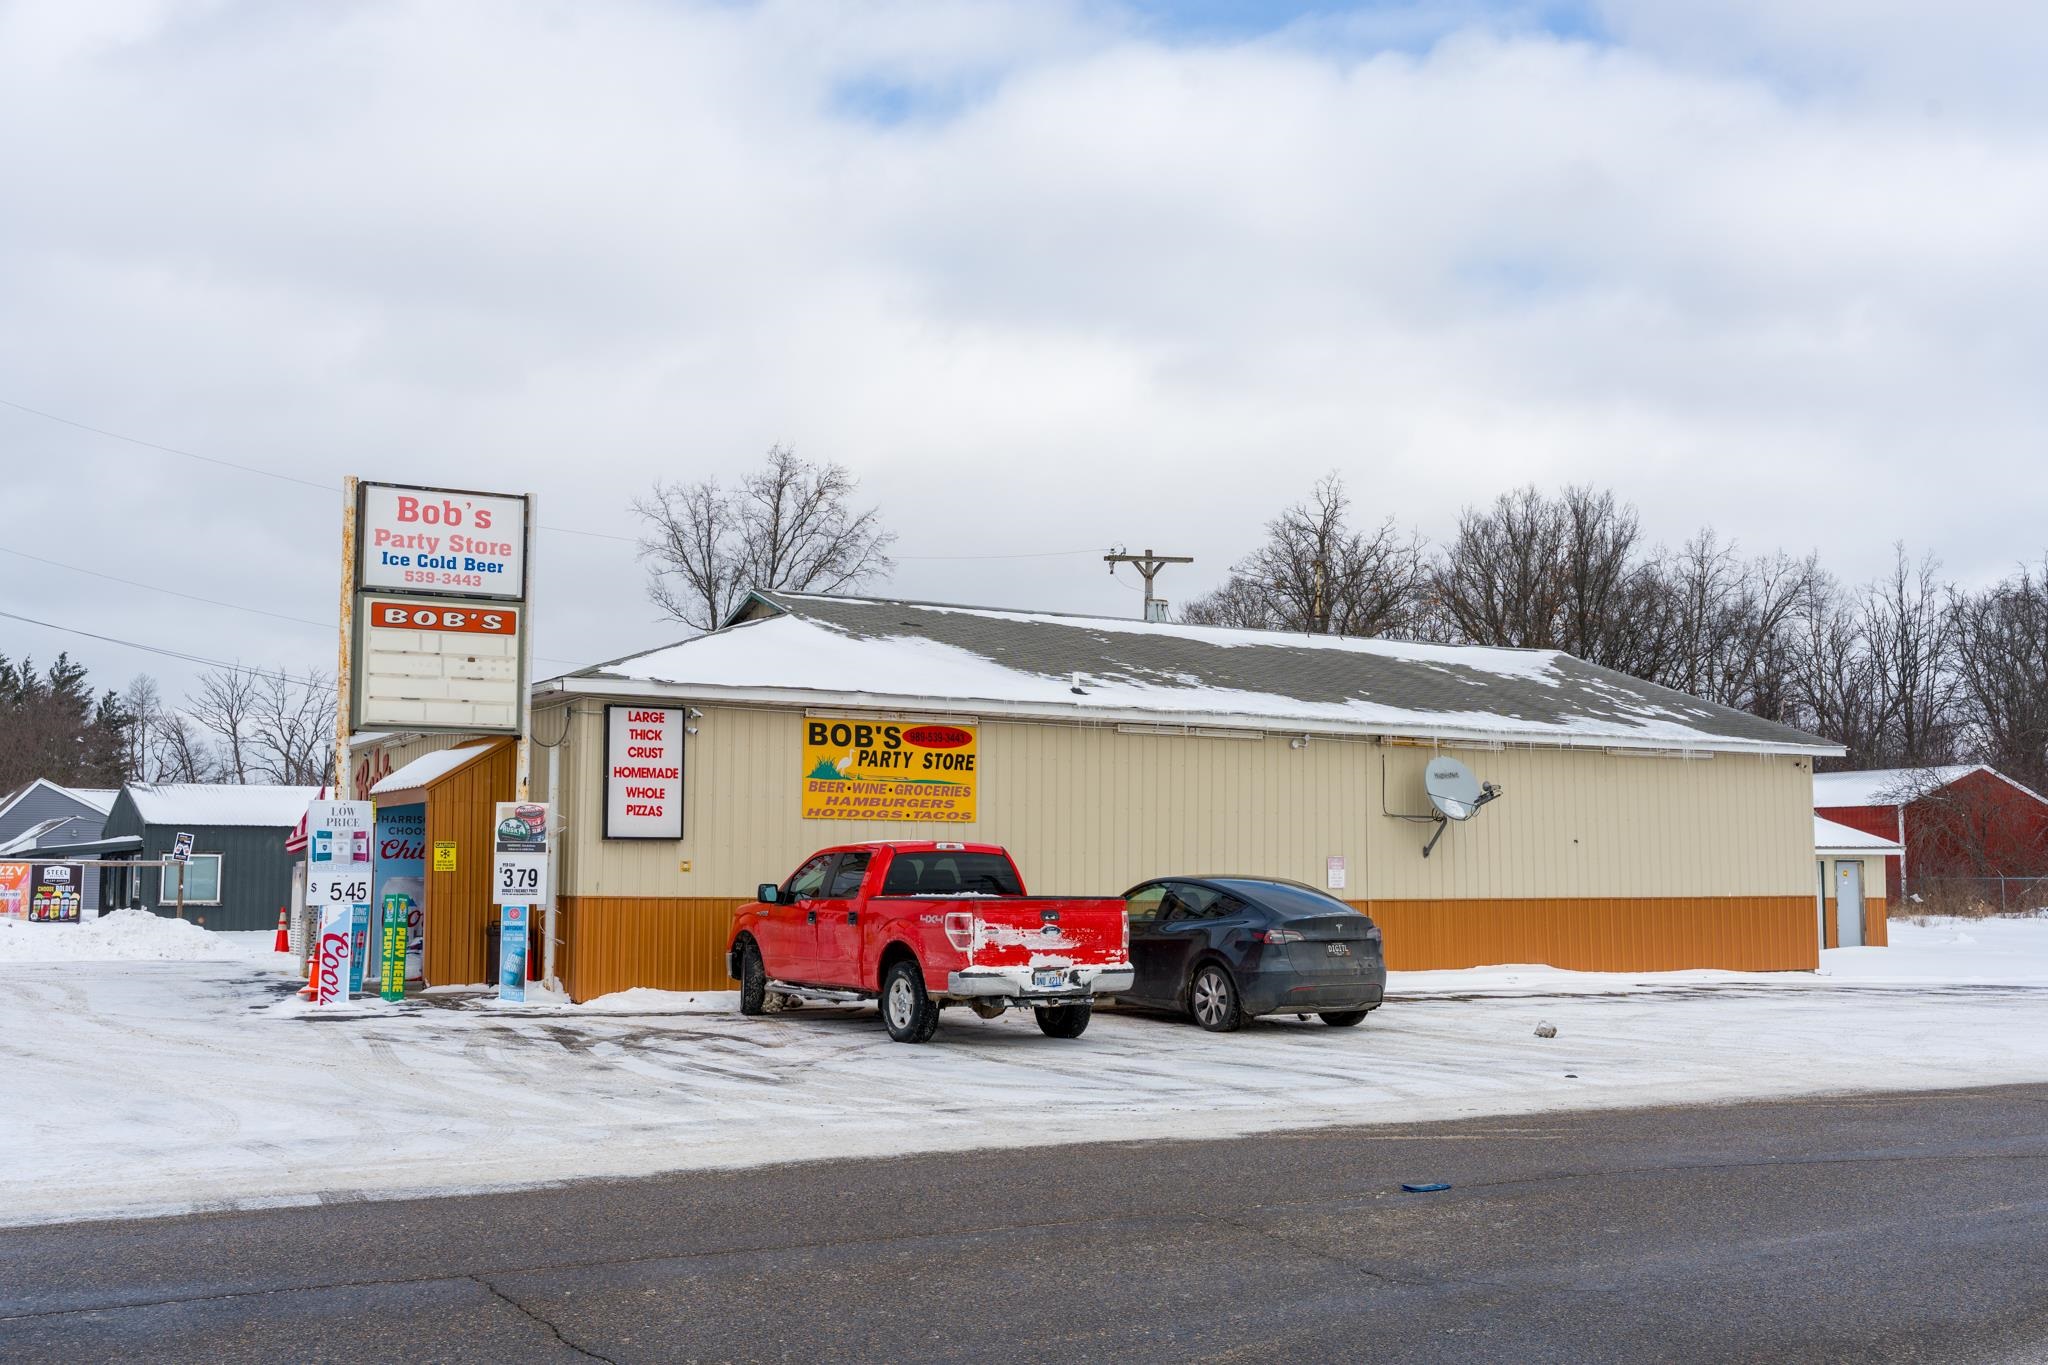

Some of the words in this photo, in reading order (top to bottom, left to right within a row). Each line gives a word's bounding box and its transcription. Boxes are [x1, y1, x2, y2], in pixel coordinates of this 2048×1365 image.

[397, 496, 492, 529] Bob's
[374, 528, 440, 555] Party
[449, 534, 512, 557] Store
[382, 551, 410, 567] Ice
[417, 554, 457, 570] Cold
[464, 557, 504, 573] Beer
[404, 570, 482, 587] 539-3443
[384, 607, 503, 630] BOB'S
[628, 711, 665, 723] LARGE
[629, 729, 663, 741] THICK
[808, 722, 902, 750] BOB'S
[910, 731, 965, 743] 989-539-3443
[627, 746, 664, 759] CRUST
[857, 750, 914, 769] PARTY
[922, 752, 976, 771] STORE
[613, 766, 679, 779] HOMEMADE
[625, 786, 665, 799] WHOLE
[808, 780, 845, 793] BEER
[852, 782, 887, 795] WINE
[894, 784, 972, 798] GROCERIES
[626, 804, 663, 817] PIZZAS
[825, 796, 956, 809] HAMBURGERS
[331, 807, 357, 817] LOW
[807, 808, 903, 819] HOTDOGS
[913, 811, 972, 820] TACOS
[326, 818, 360, 827] PRICE
[503, 868, 538, 889] 3.79
[310, 882, 317, 893] $
[330, 881, 367, 902] 5.45
[383, 927, 393, 958] PLAY
[395, 927, 406, 958] PLAY
[1327, 944, 1349, 953] DIGITL
[381, 961, 391, 993] HERE
[392, 961, 405, 993] HERE
